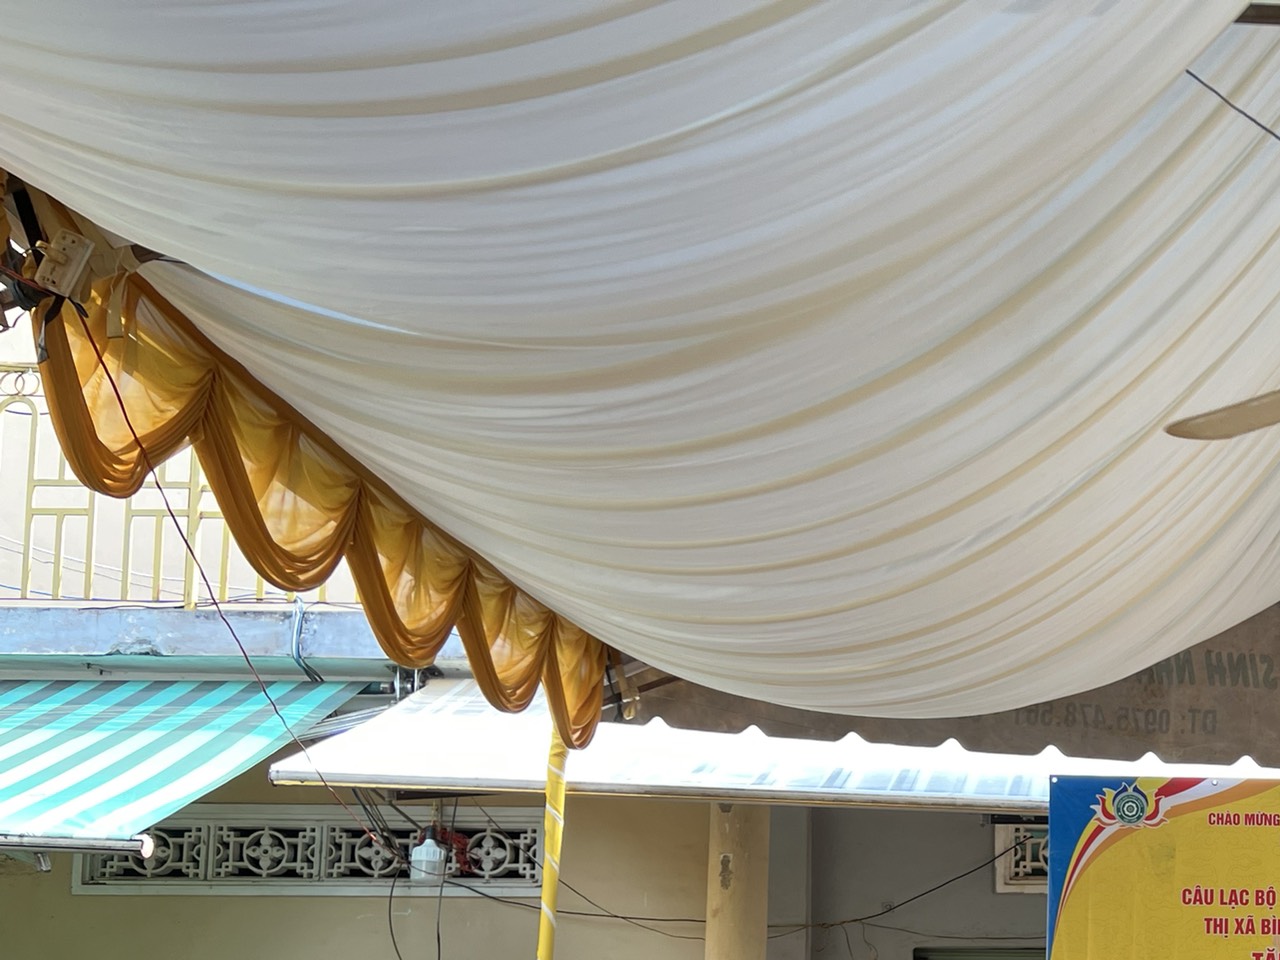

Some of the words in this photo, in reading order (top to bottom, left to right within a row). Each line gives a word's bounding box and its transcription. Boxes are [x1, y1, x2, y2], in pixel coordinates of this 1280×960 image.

[1208, 811, 1240, 826] CHÀO
[1244, 811, 1280, 826] MỪNG
[1182, 885, 1214, 905] CÂU
[1219, 888, 1249, 909] LẠC
[1255, 886, 1276, 909] BỘ
[1204, 918, 1229, 938] THỊ
[1234, 915, 1256, 935] XÃ
